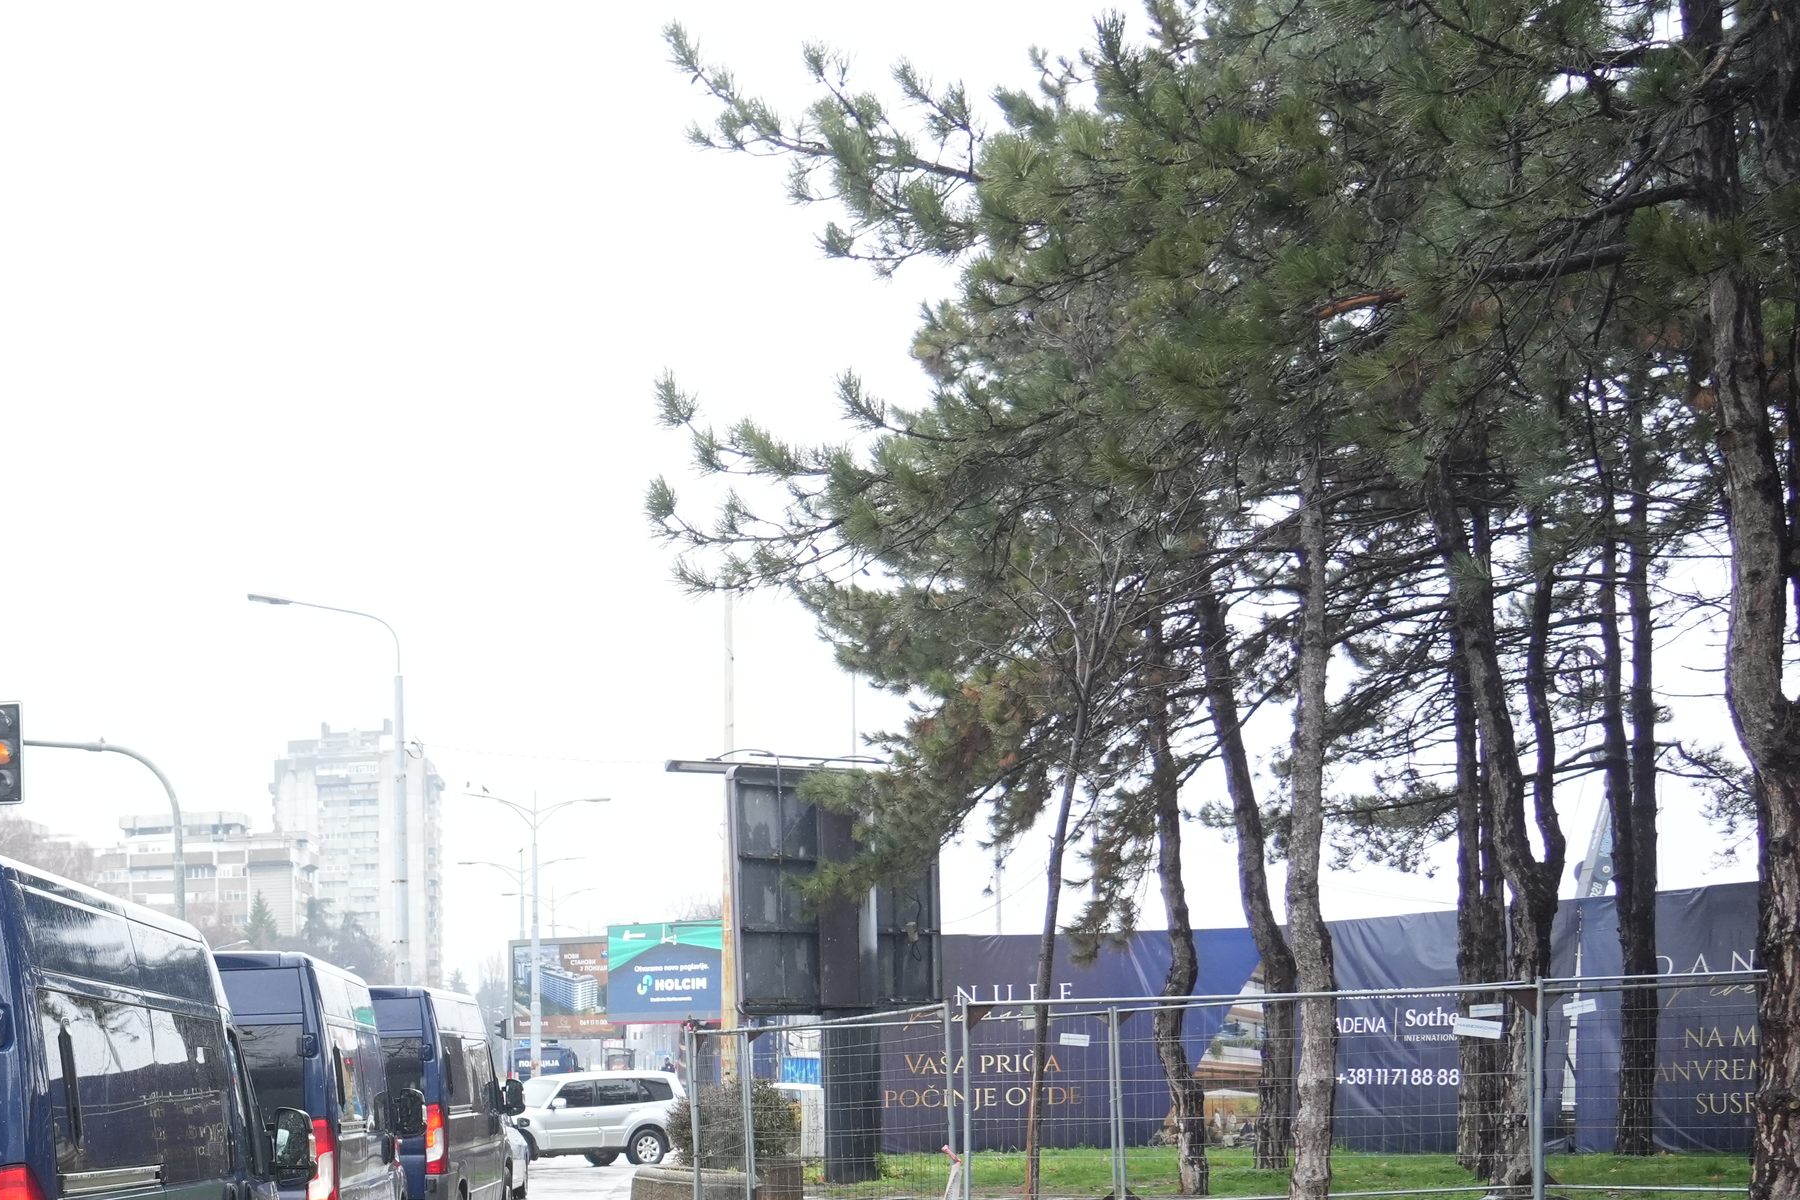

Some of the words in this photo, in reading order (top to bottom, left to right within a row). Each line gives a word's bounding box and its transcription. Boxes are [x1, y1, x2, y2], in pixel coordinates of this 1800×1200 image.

[654, 977, 707, 991] HOLCIM
[1684, 1026, 1725, 1049] NA
[518, 1060, 560, 1068] ПОЦИЈА
[1336, 1068, 1372, 1085] +381
[1375, 1068, 1388, 1085] 11
[1391, 1068, 1407, 1085] 71
[1411, 1068, 1433, 1086] 88
[1436, 1068, 1460, 1086] 88
[1005, 1086, 1082, 1106] ODE
